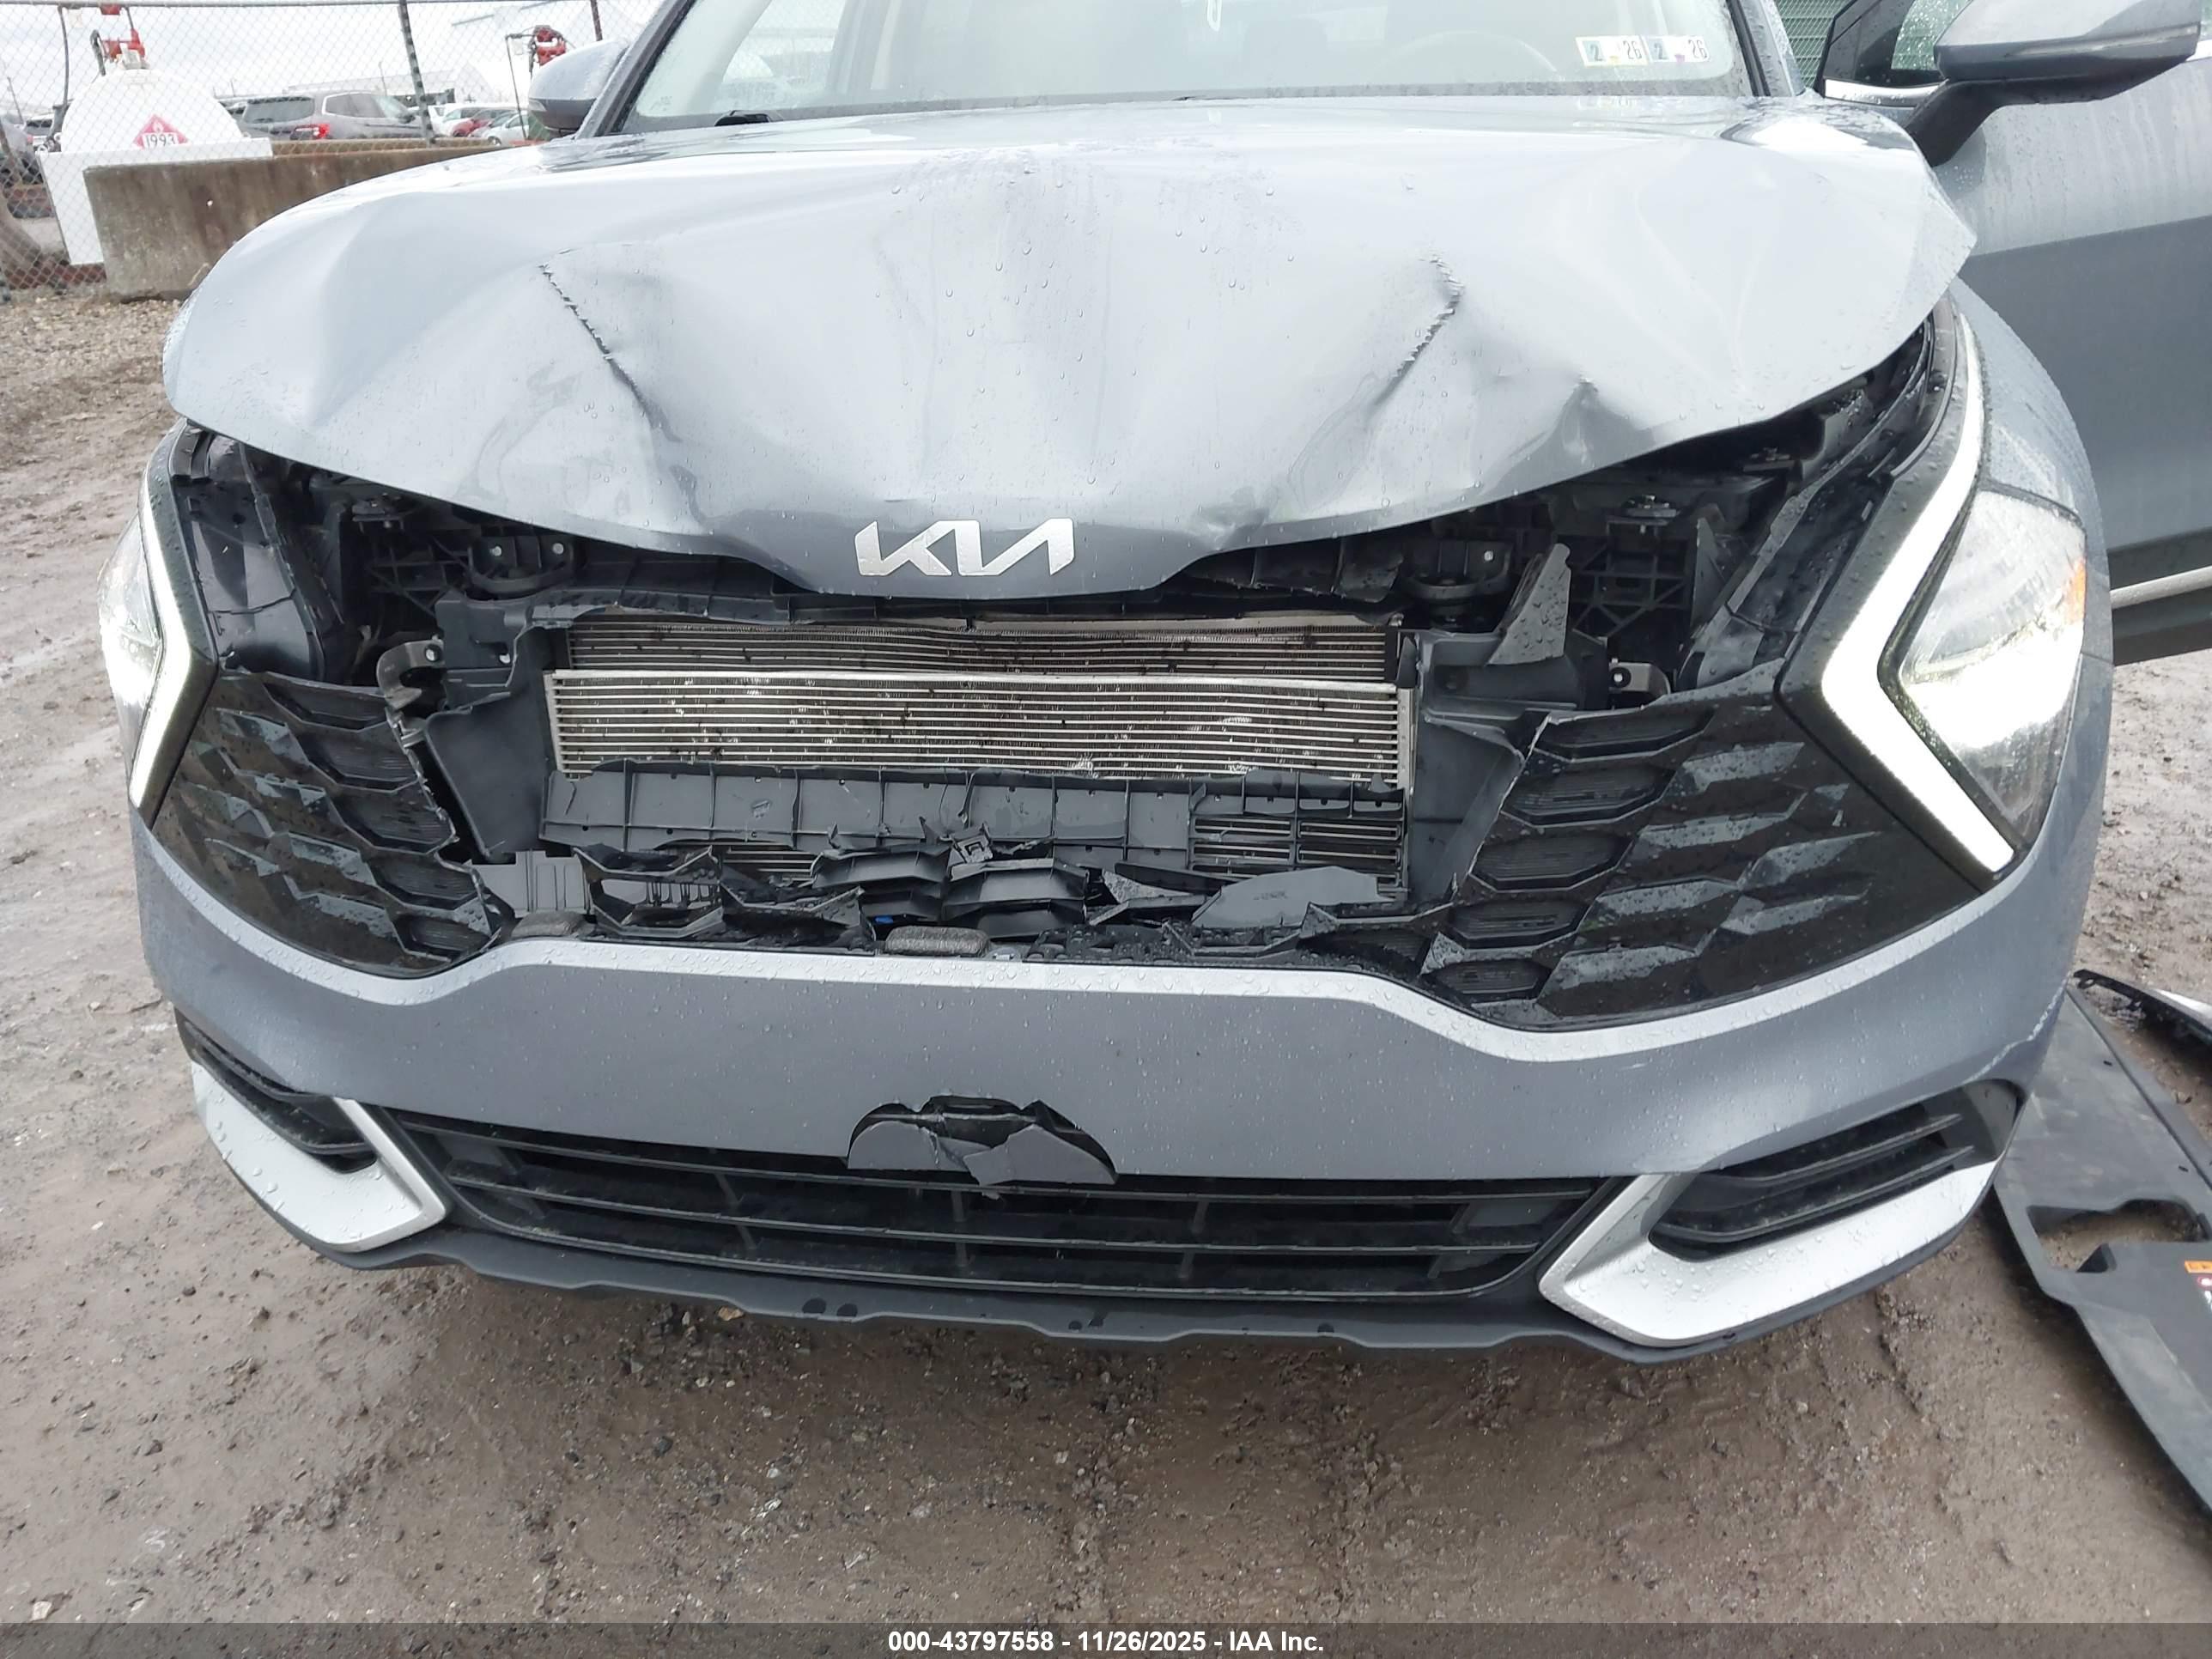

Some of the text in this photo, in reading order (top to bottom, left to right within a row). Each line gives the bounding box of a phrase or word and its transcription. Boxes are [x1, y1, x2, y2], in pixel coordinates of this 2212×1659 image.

[1590, 40, 1642, 61] 2 26
[1655, 40, 1708, 60] 2 26
[854, 518, 1074, 576] KIA
